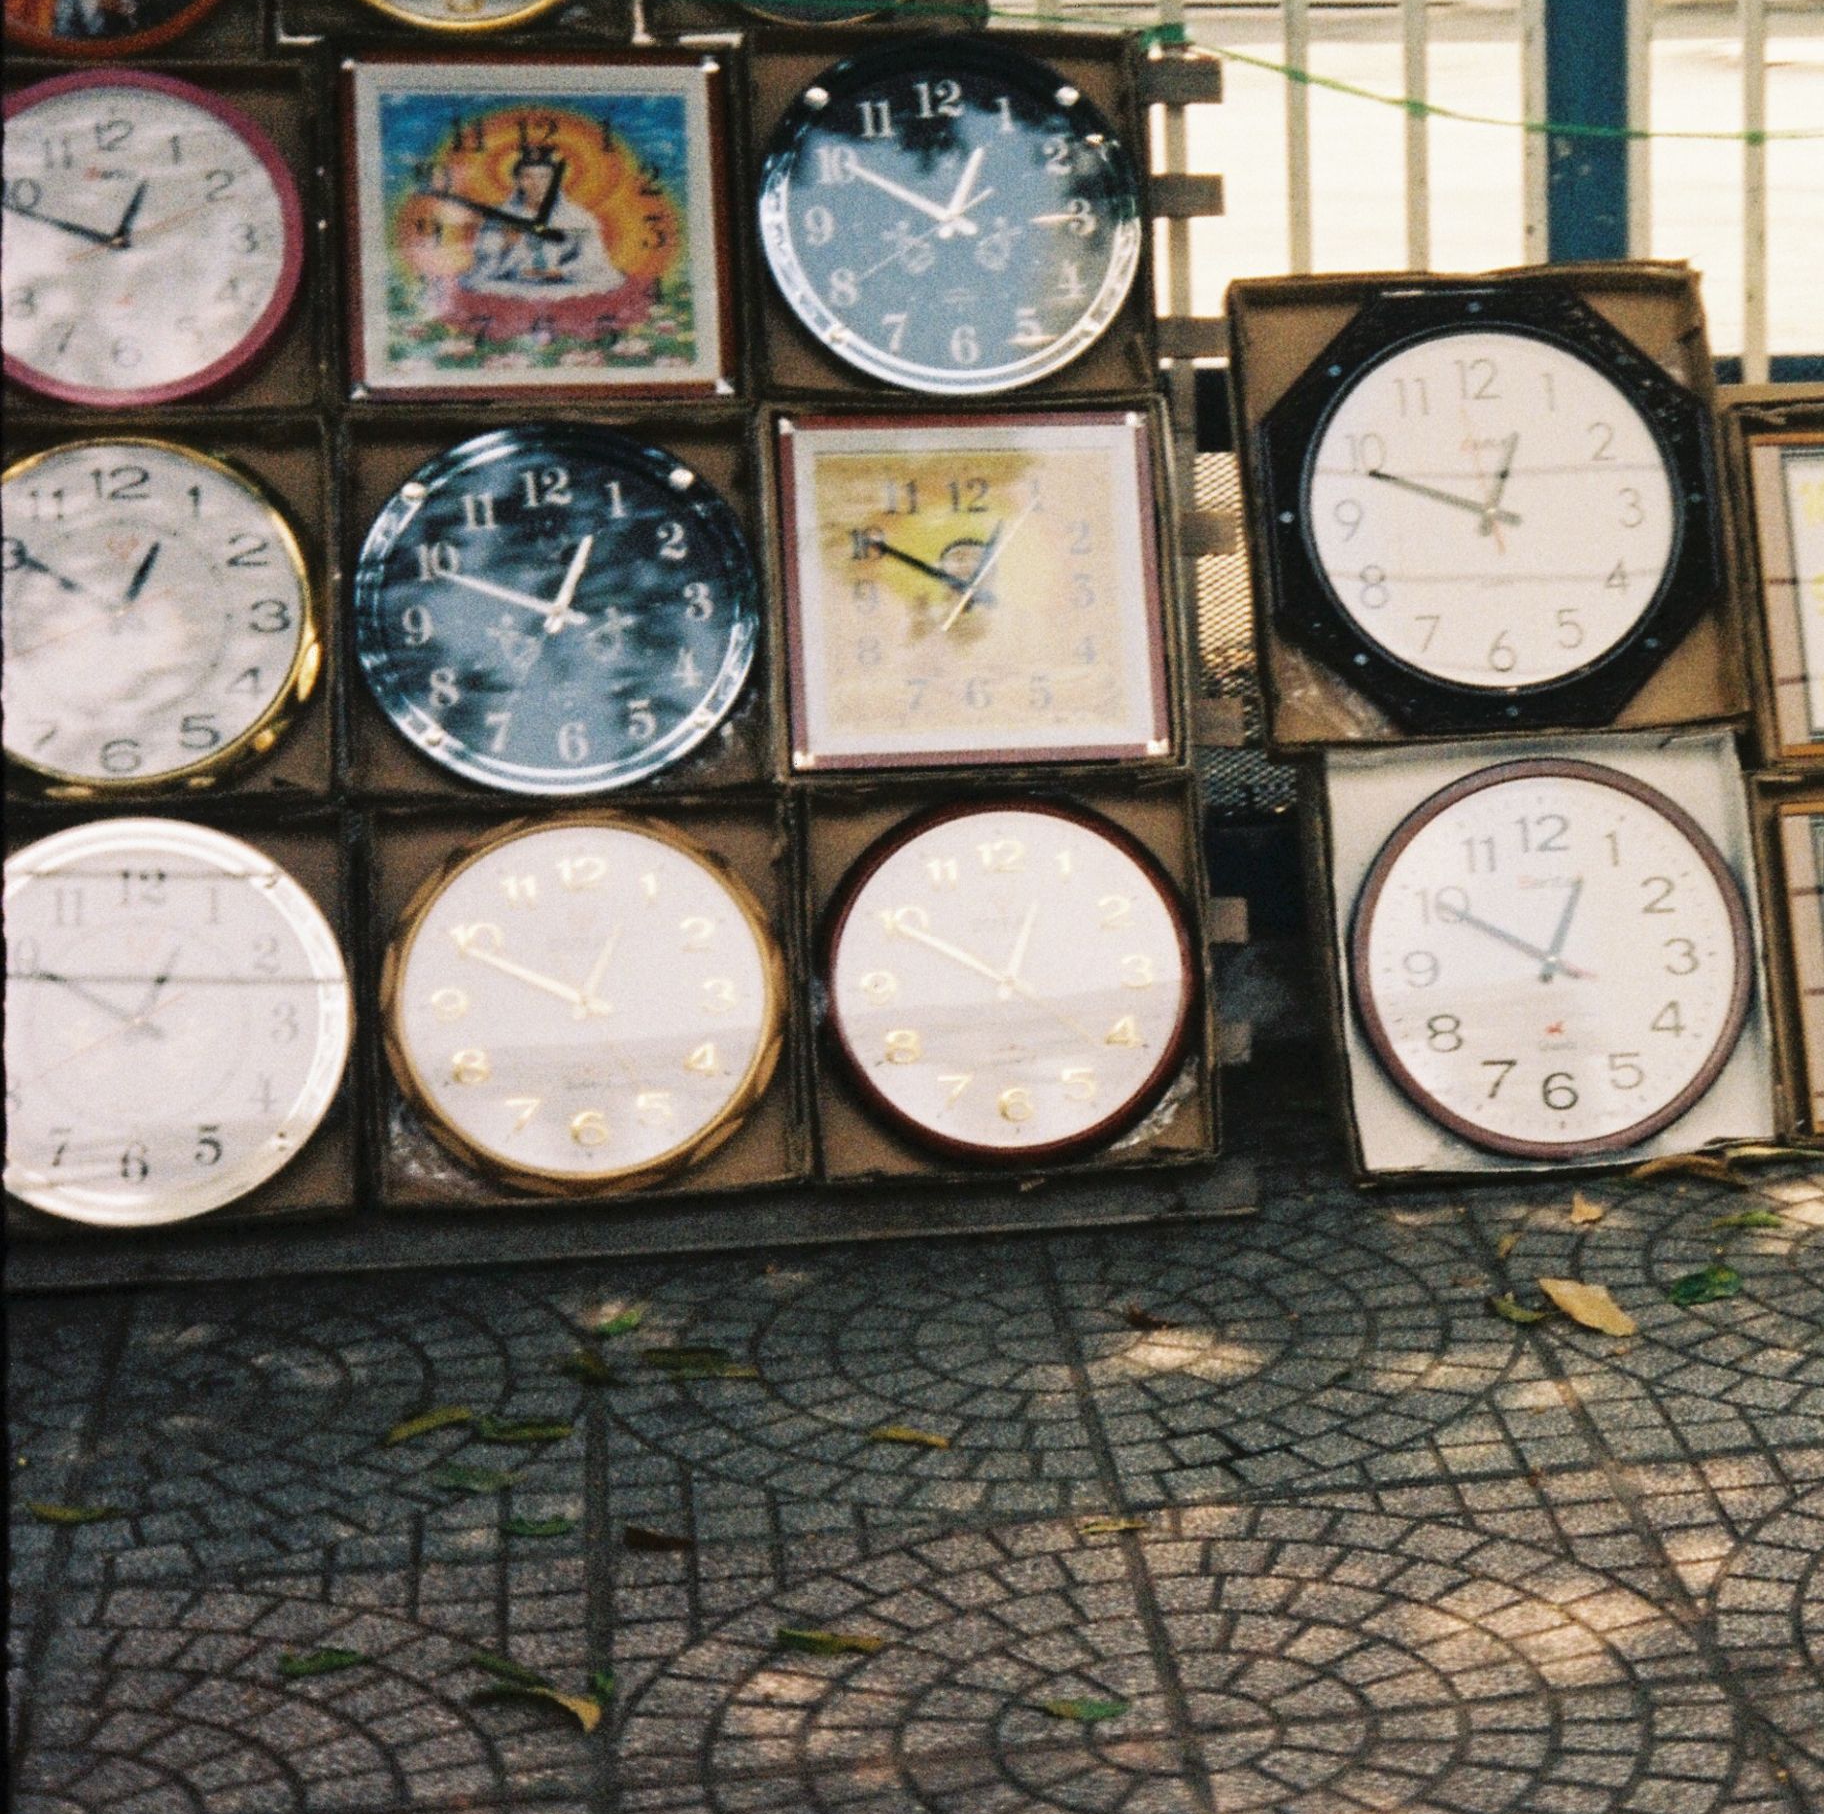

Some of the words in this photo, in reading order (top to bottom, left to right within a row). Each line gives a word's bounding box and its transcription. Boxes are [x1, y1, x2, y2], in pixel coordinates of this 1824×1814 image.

[913, 79, 965, 118] 12
[997, 96, 1015, 134] 1
[453, 117, 485, 153] 11
[857, 100, 896, 138] 11
[814, 145, 859, 185] 10
[1042, 138, 1072, 176] 2
[206, 170, 235, 202] 2
[805, 206, 835, 247] 9
[1067, 198, 1097, 237] 3
[830, 268, 859, 307] 8
[881, 313, 908, 357] 7
[950, 325, 980, 365] 6
[1015, 308, 1044, 347] 5
[1393, 378, 1429, 417] 11
[1454, 358, 1501, 401] 12
[1541, 373, 1556, 412] 1
[1346, 433, 1386, 473] 10
[1587, 421, 1616, 462] 2
[90, 465, 150, 502] 12
[188, 484, 201, 518] 1
[521, 467, 572, 507] 12
[605, 482, 626, 518] 1
[885, 478, 920, 515] 11
[947, 477, 990, 513] 12
[462, 493, 498, 531] 11
[1333, 498, 1365, 542] 9
[1618, 487, 1645, 529] 3
[227, 534, 268, 568] 2
[656, 522, 687, 560] 2
[850, 528, 884, 560] 10
[1066, 522, 1091, 556] 2
[416, 542, 460, 582] 10
[1606, 557, 1631, 593] 4
[683, 582, 714, 622] 3
[1072, 574, 1096, 609] 3
[1359, 564, 1390, 610] 8
[250, 599, 291, 633] 3
[402, 604, 433, 646] 9
[1414, 614, 1441, 654] 7
[1555, 607, 1585, 649] 5
[671, 647, 703, 687] 4
[1074, 636, 1097, 664] 4
[1488, 630, 1517, 673] 6
[226, 666, 264, 698] 4
[429, 667, 460, 708] 8
[180, 714, 221, 750] 5
[484, 711, 512, 753] 7
[626, 699, 656, 740] 5
[102, 739, 143, 773] 6
[557, 721, 589, 763] 6
[1515, 813, 1570, 853] 12
[1605, 831, 1620, 868] 1
[927, 857, 958, 890] 11
[977, 839, 1026, 873] 12
[1460, 835, 1498, 874] 11
[502, 874, 539, 911] 11
[556, 856, 606, 892] 12
[641, 871, 659, 904] 1
[1414, 885, 1470, 925] 10
[1639, 876, 1676, 915] 2
[679, 915, 716, 953] 2
[1403, 950, 1440, 988] 9
[1662, 938, 1700, 976] 3
[431, 988, 469, 1022] 9
[701, 978, 736, 1014] 3
[859, 969, 897, 1007] 9
[1104, 1015, 1140, 1050] 4
[1425, 1014, 1464, 1053] 8
[1650, 1000, 1686, 1038] 4
[451, 1049, 489, 1084] 8
[684, 1042, 718, 1077] 4
[884, 1030, 922, 1065] 8
[1061, 1066, 1097, 1101] 5
[1481, 1058, 1518, 1100] 7
[1607, 1052, 1646, 1090] 5
[937, 1073, 974, 1109] 7
[999, 1087, 1034, 1123] 6
[1540, 1072, 1580, 1111] 6
[505, 1096, 541, 1134] 7
[570, 1110, 607, 1147] 6
[120, 1139, 149, 1183] 6
[194, 1124, 223, 1166] 5
